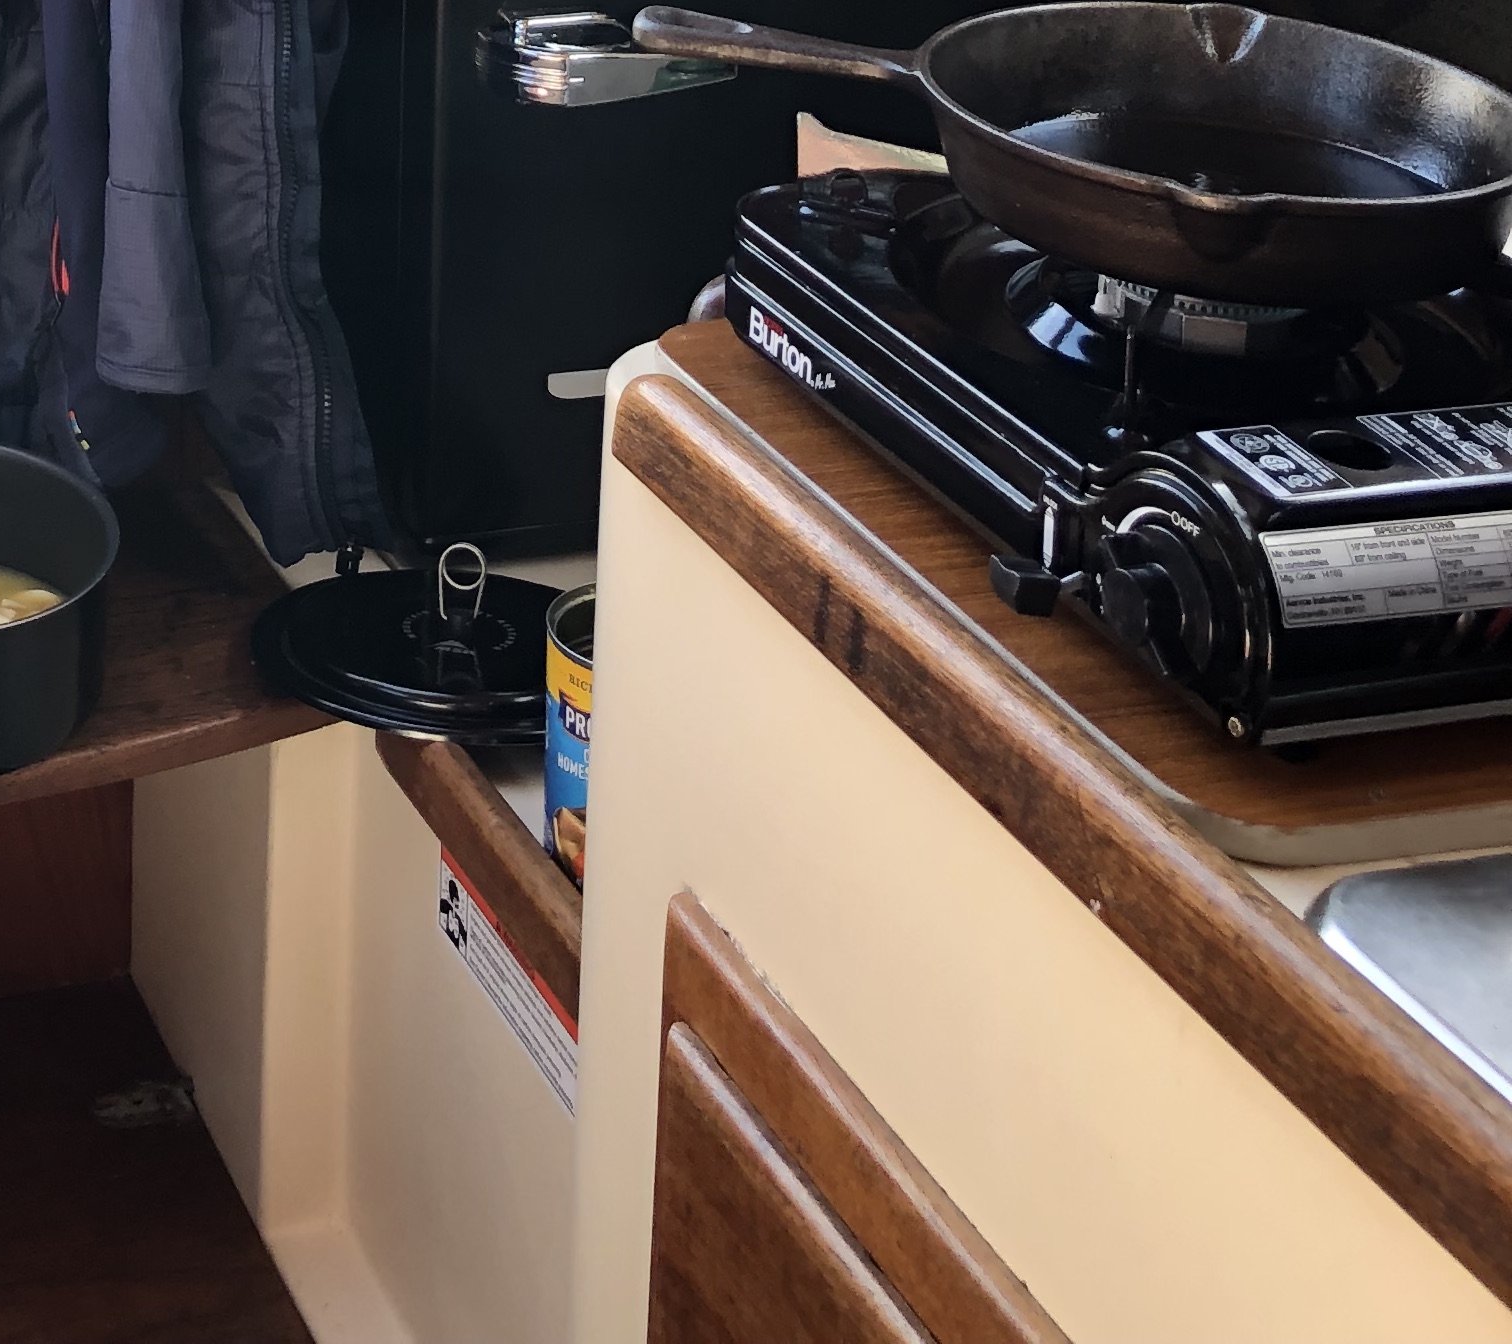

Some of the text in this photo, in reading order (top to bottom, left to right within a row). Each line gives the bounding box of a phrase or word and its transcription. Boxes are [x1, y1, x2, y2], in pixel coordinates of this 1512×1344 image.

[749, 306, 813, 385] Burton
[1181, 517, 1200, 537] OFF
[1374, 520, 1456, 535] SPECIFICATIONS
